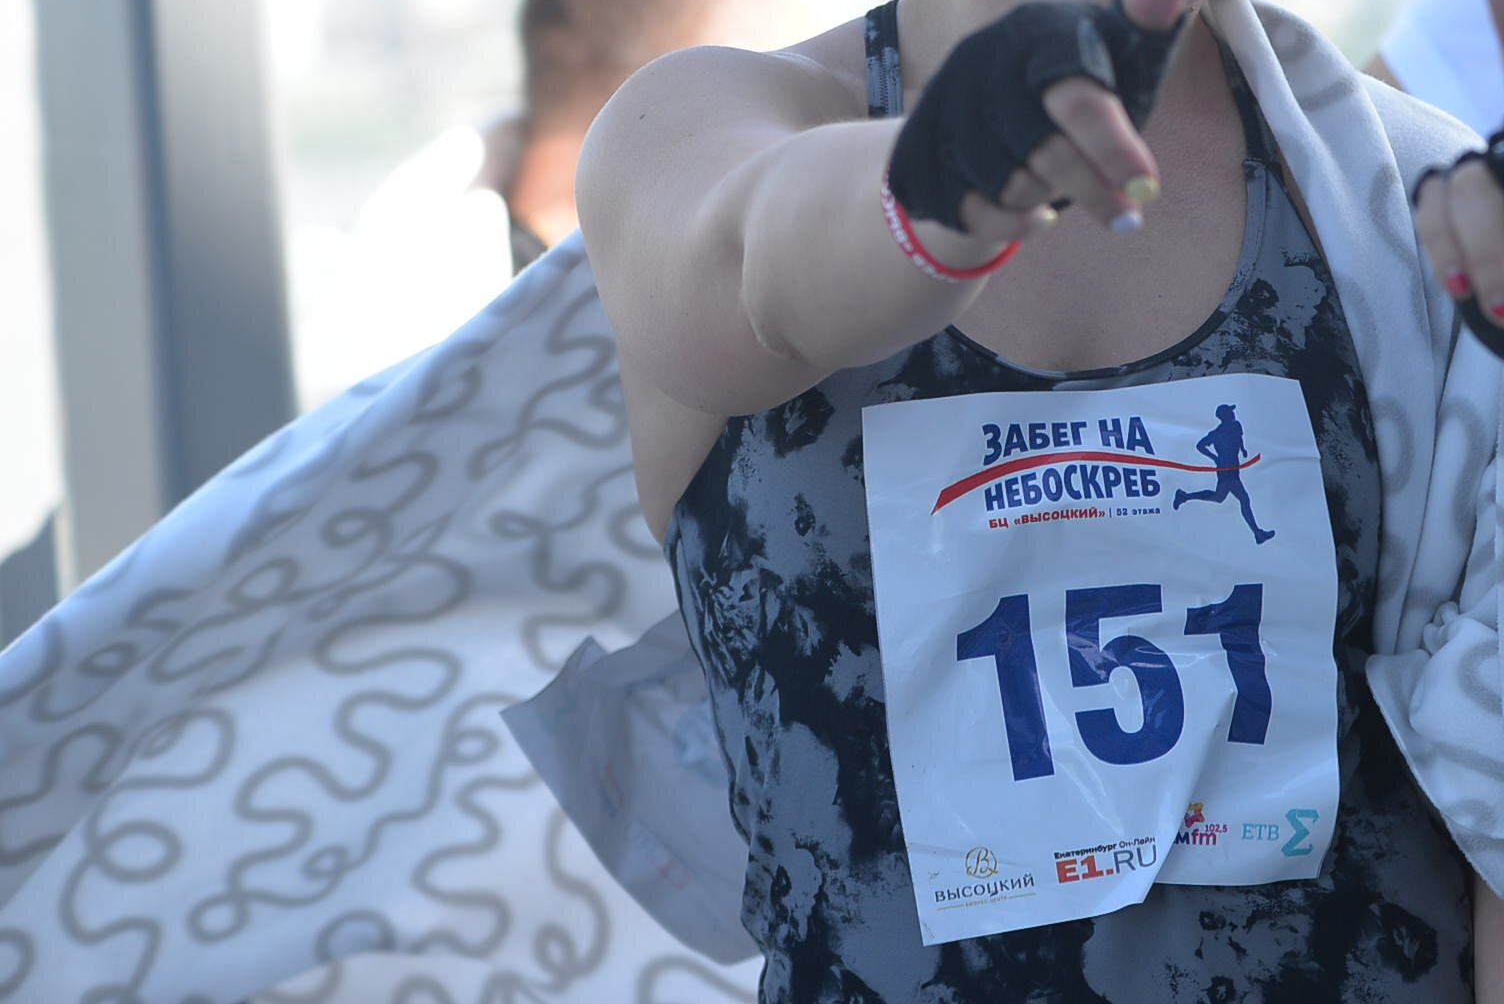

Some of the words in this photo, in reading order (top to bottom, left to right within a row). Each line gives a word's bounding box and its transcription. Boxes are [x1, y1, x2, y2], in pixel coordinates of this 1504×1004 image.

[981, 421, 1088, 466] ЗАБЕГ
[1097, 416, 1156, 456] НА
[984, 463, 1161, 512] НЕБОСКРЕБ
[988, 517, 1009, 529] БЦ
[955, 582, 1273, 783] 151
[1055, 844, 1158, 885] E1.RU
[934, 872, 1035, 903] ВЫСОЦКИЙ
